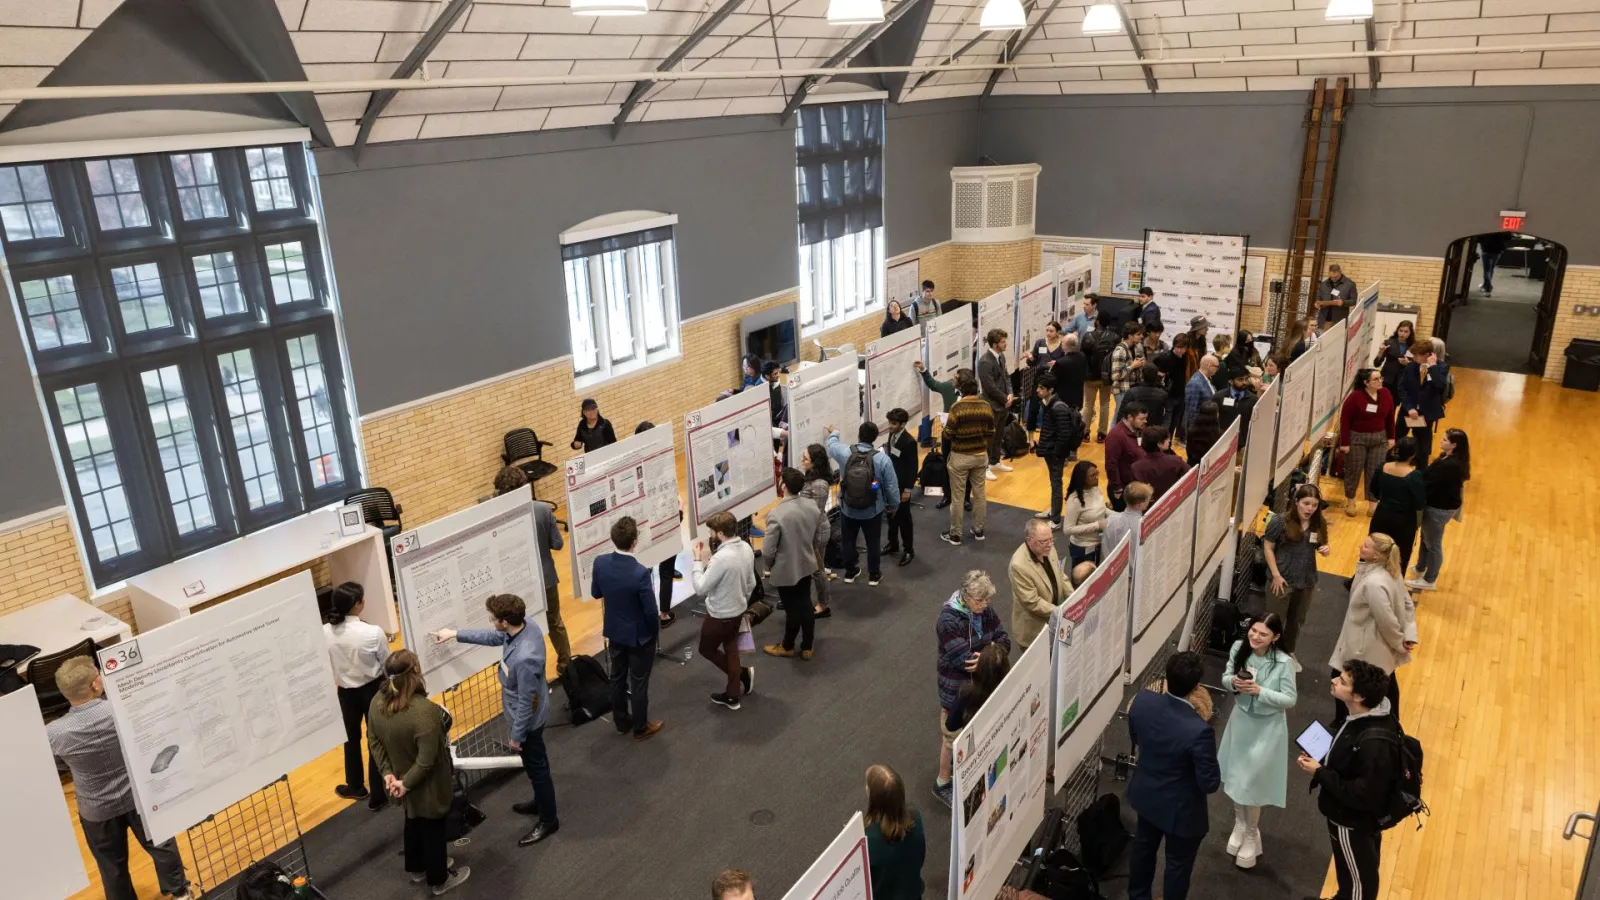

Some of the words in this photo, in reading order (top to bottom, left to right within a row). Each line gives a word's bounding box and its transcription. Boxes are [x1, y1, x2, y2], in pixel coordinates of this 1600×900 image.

[1503, 217, 1521, 229] EXIT
[575, 461, 584, 470] 38
[404, 535, 416, 547] 37
[117, 678, 133, 689] Mesh
[134, 671, 153, 684] Density
[154, 659, 184, 674] Uncertainty
[184, 644, 218, 661] Quantification
[226, 629, 253, 643] Automotive
[253, 623, 265, 632] Wind
[265, 617, 280, 626] Tunnel
[118, 647, 138, 662] 36
[119, 680, 144, 693] Modeling
